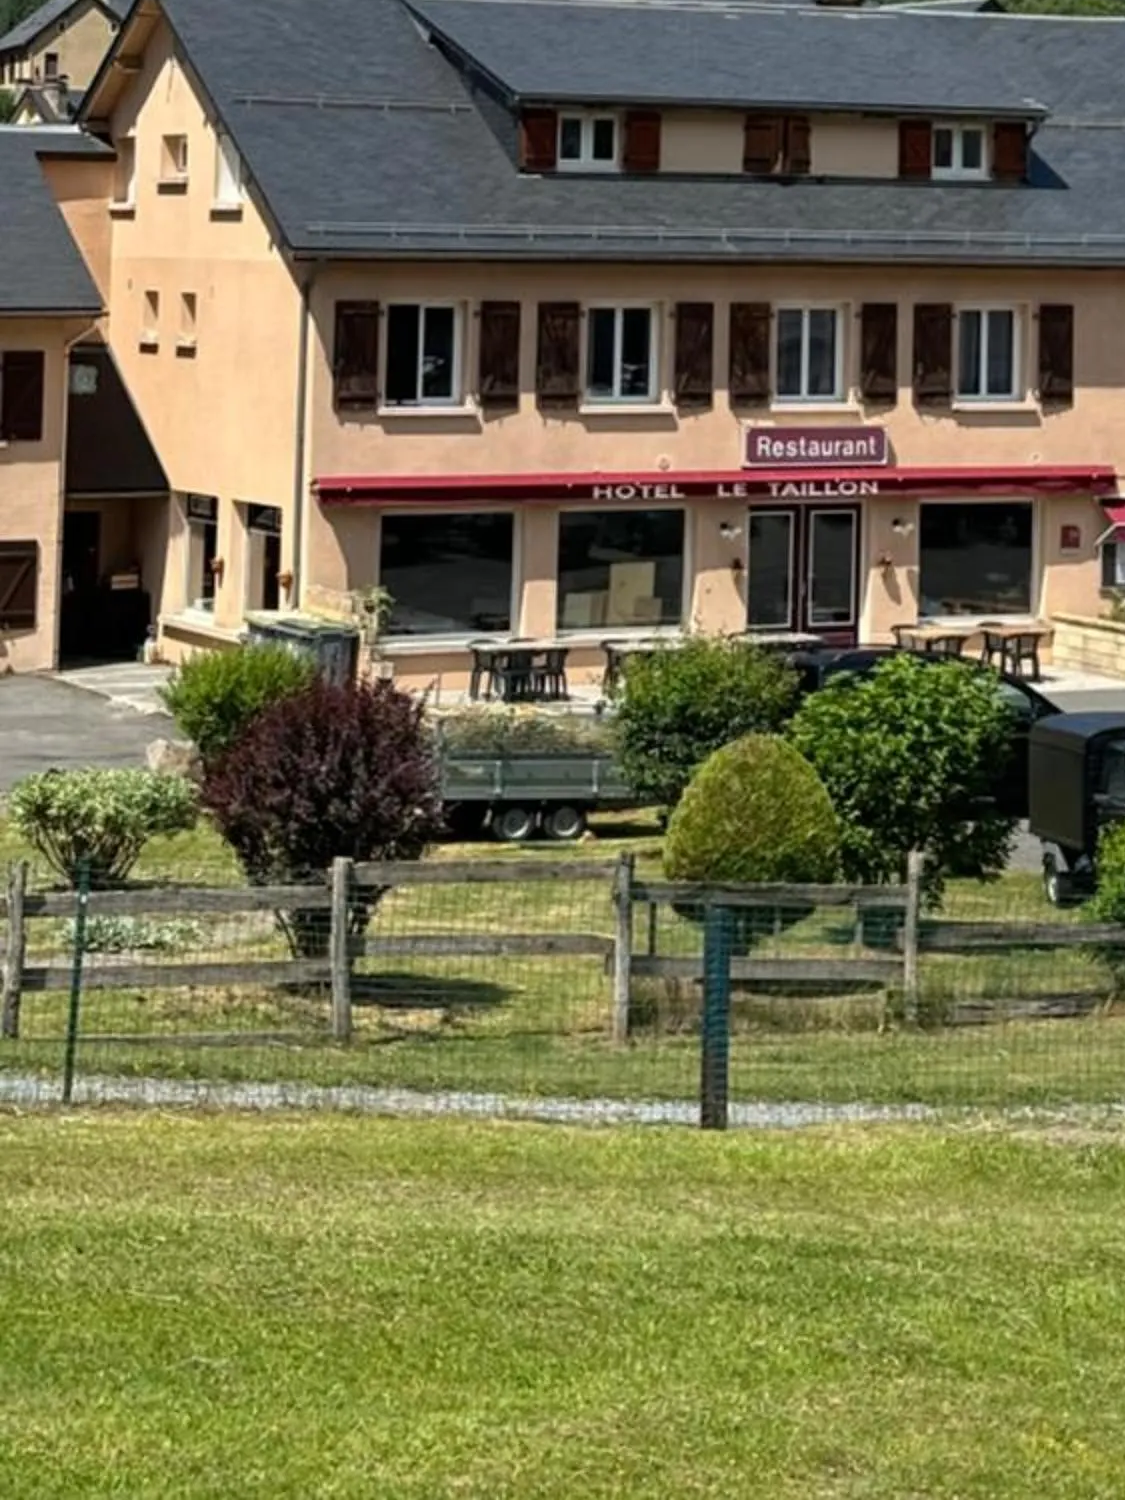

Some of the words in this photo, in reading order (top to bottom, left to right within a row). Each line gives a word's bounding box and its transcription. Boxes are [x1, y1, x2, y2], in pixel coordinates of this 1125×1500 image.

[756, 435, 877, 458] Restaurant
[592, 484, 686, 500] HOTEL
[717, 483, 748, 498] LE
[767, 480, 880, 497] TAILLON
